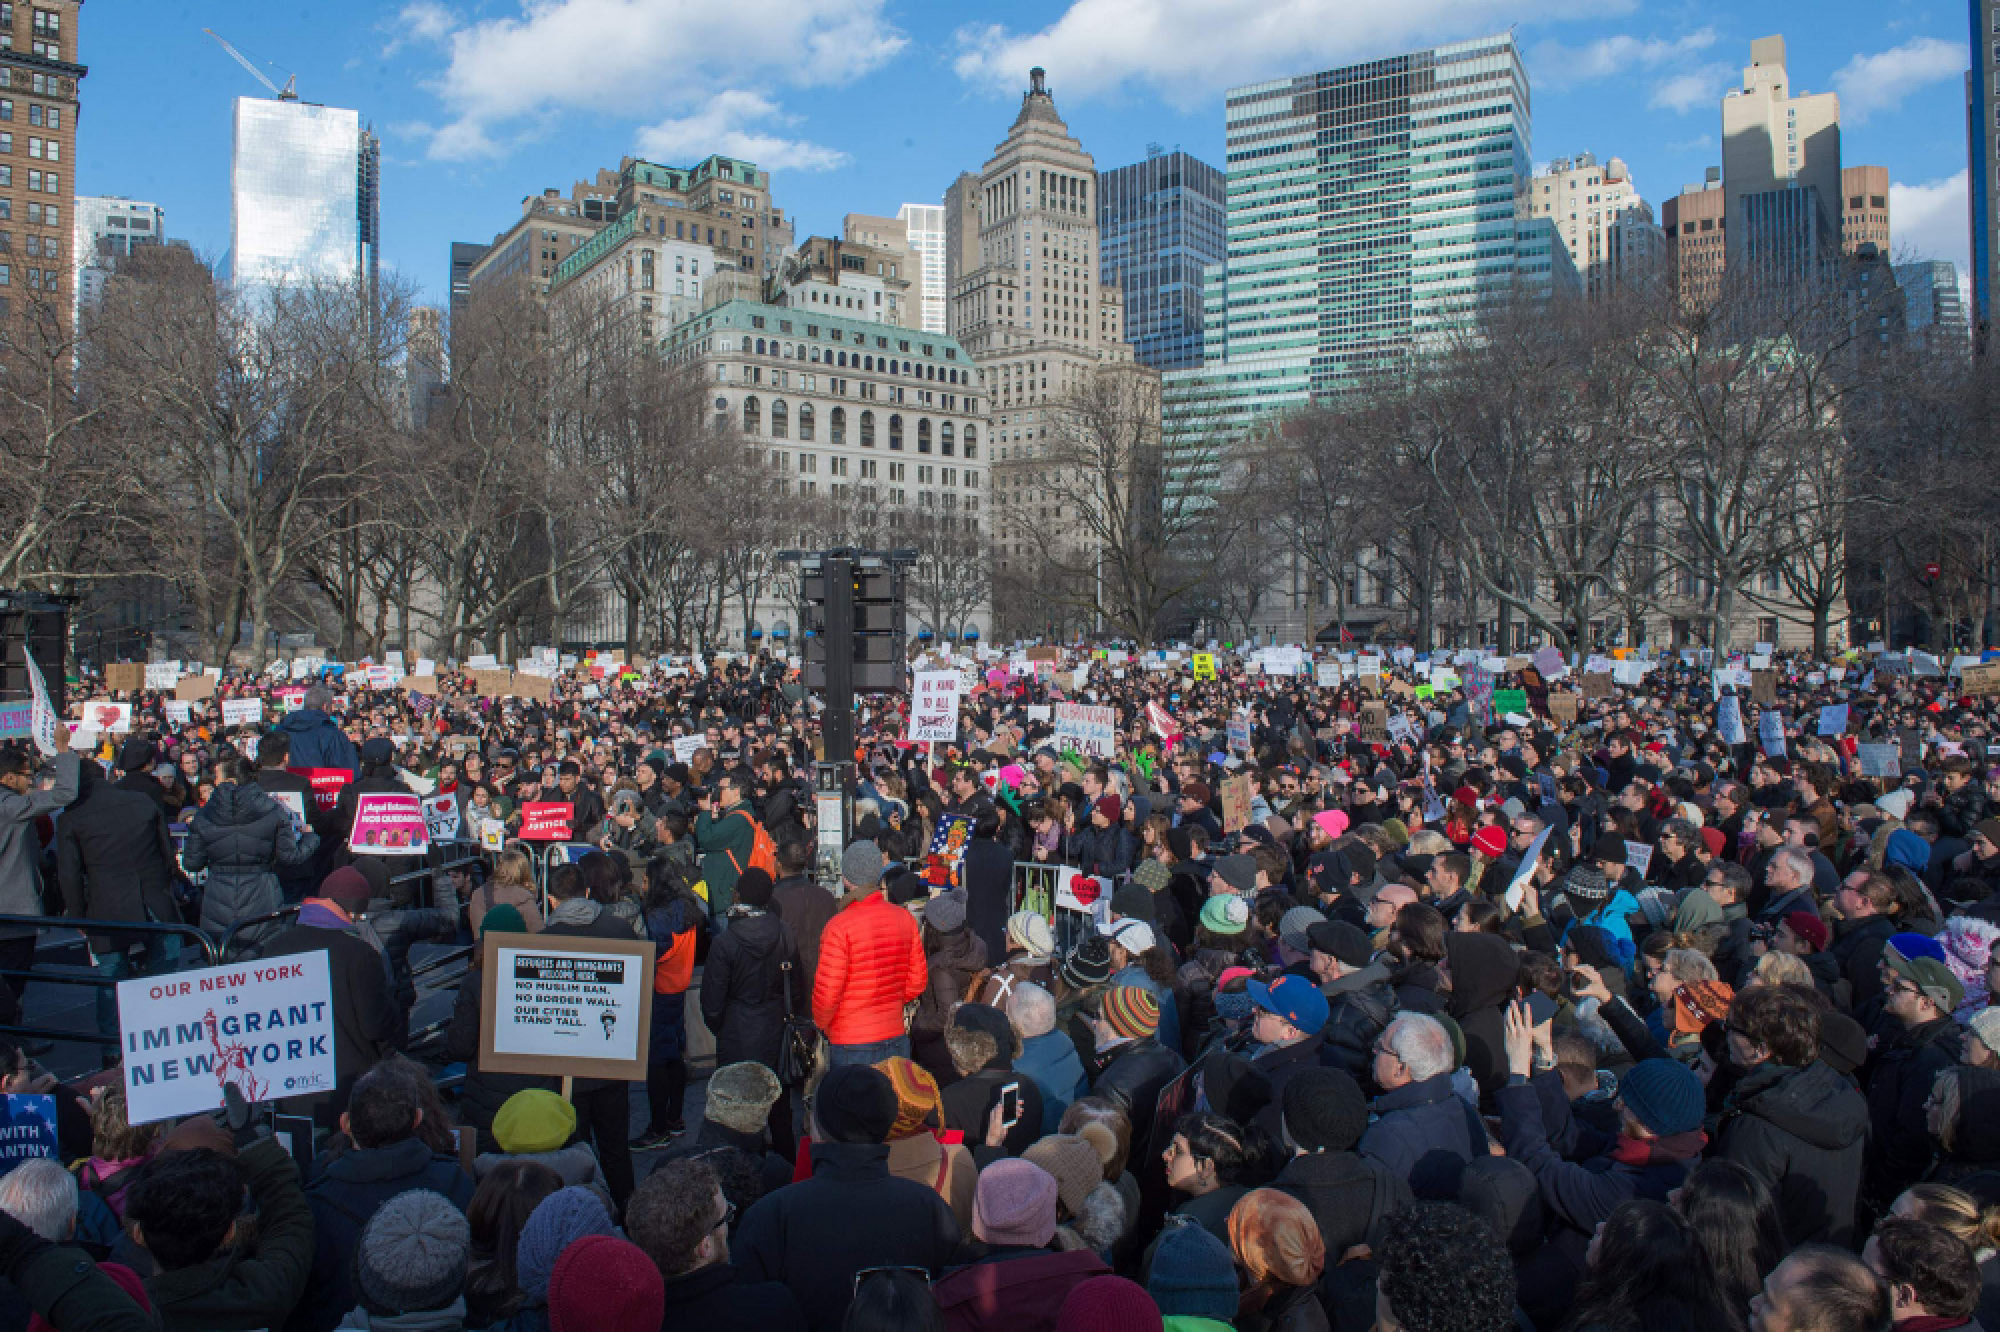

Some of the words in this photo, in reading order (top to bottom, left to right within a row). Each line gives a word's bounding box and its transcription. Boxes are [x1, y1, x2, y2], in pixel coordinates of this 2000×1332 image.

[426, 804, 432, 816] I
[428, 817, 456, 834] NY
[1078, 883, 1098, 892] LOVE
[150, 981, 191, 1000] OUR
[200, 972, 246, 992] NEW
[254, 963, 303, 983] YORK
[515, 981, 532, 990] NO
[536, 982, 579, 992] MUSLIM
[584, 985, 610, 994] BAN.
[226, 995, 238, 1004] IS
[515, 993, 532, 1002] NO
[536, 994, 582, 1004] BORDER
[514, 1005, 538, 1014] OUR
[542, 1007, 579, 1016] CITIES
[514, 1015, 552, 1024] STAND
[556, 1017, 586, 1026] TALL.
[132, 1052, 214, 1086] NEW
[243, 1034, 328, 1066] YORK
